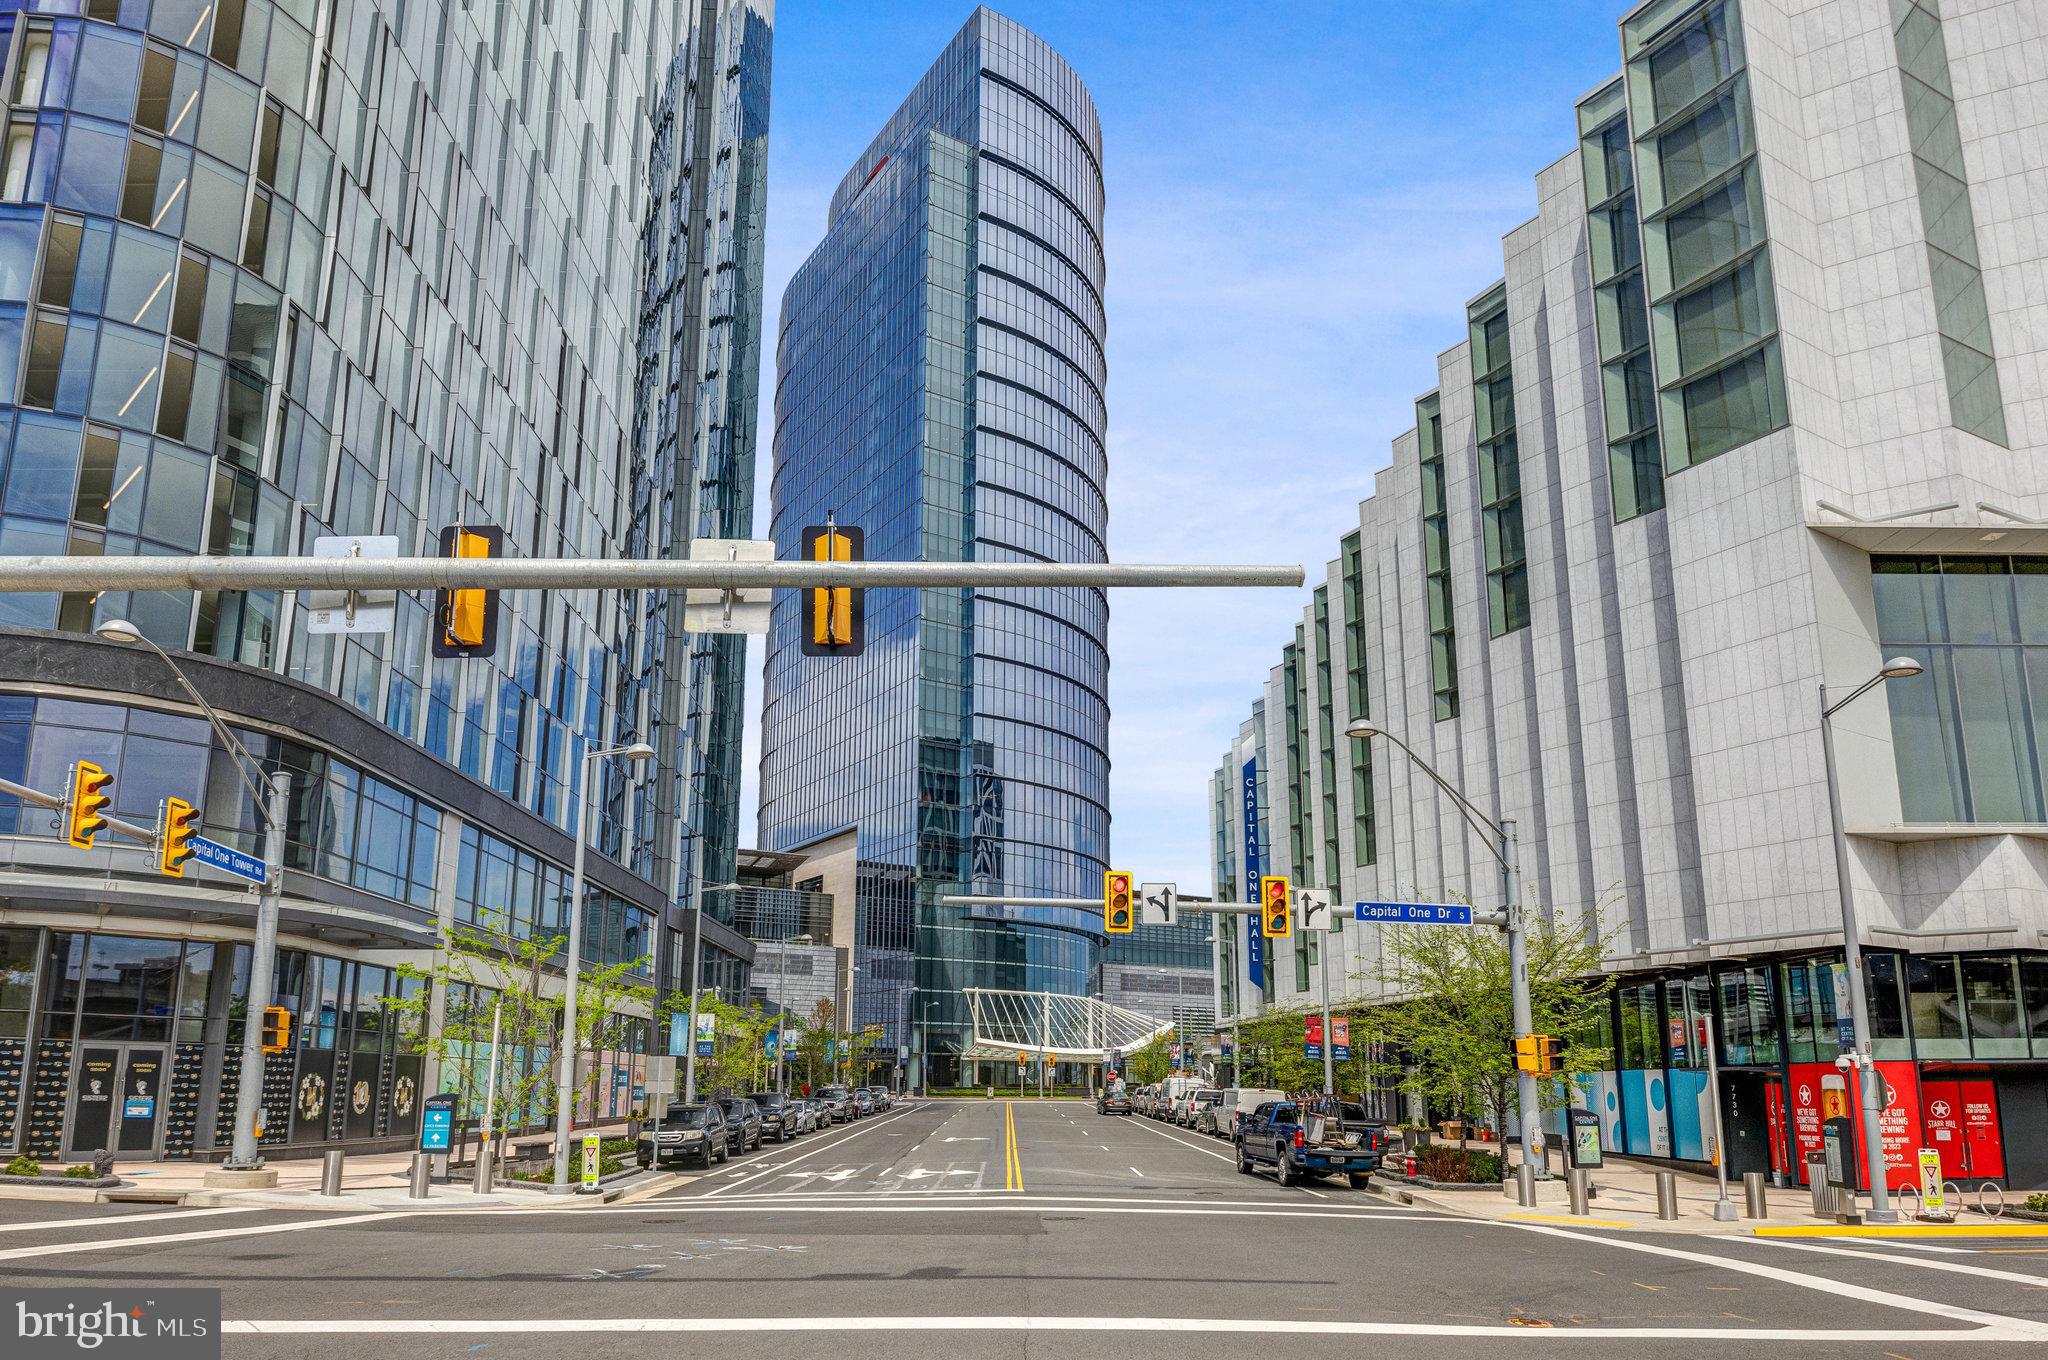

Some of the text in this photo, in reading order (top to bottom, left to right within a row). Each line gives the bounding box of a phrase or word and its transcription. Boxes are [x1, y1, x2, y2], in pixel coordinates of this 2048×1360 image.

[186, 838, 263, 876] Capital One Tower Rd
[1245, 778, 1259, 962] CAPITAL ONE HALL
[1362, 905, 1401, 918] Capital
[1408, 907, 1431, 918] One
[1438, 908, 1451, 919] Dr
[1796, 1108, 1817, 1116] WE'VE GOT
[1892, 1109, 1905, 1117] GOT
[1796, 1116, 1819, 1125] SOMETHING
[1879, 1117, 1909, 1126] METHING
[1928, 1120, 1957, 1129] STARR HILL
